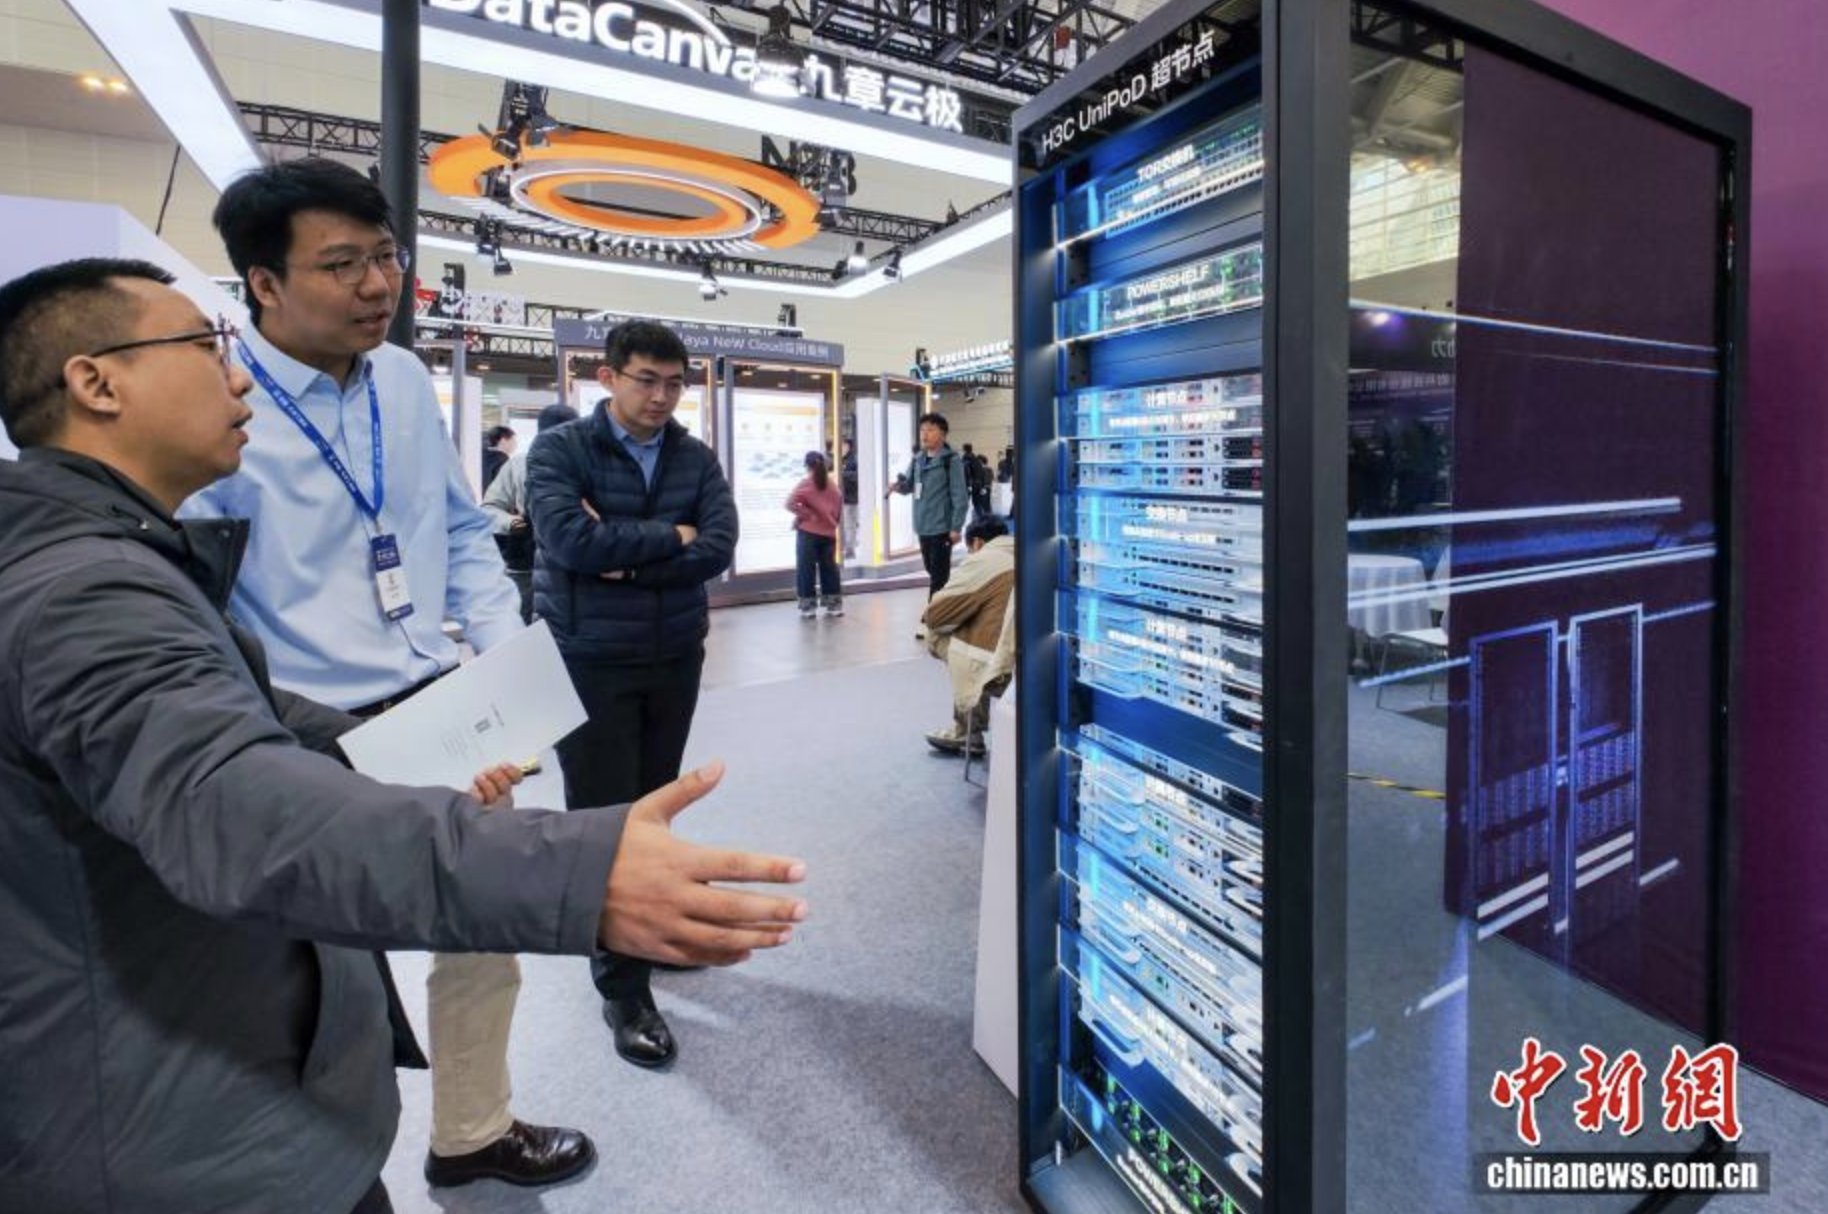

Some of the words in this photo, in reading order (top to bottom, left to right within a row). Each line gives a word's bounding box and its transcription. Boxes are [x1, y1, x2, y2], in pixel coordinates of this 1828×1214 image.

[428, 0, 772, 88] ataCanva
[803, 54, 963, 133] 九章云极
[1042, 117, 1076, 154] H3C
[1079, 74, 1147, 132] UniPoD
[1151, 30, 1215, 91] 超节点
[1127, 265, 1209, 299] POWERSHELF
[713, 336, 746, 350] NeW
